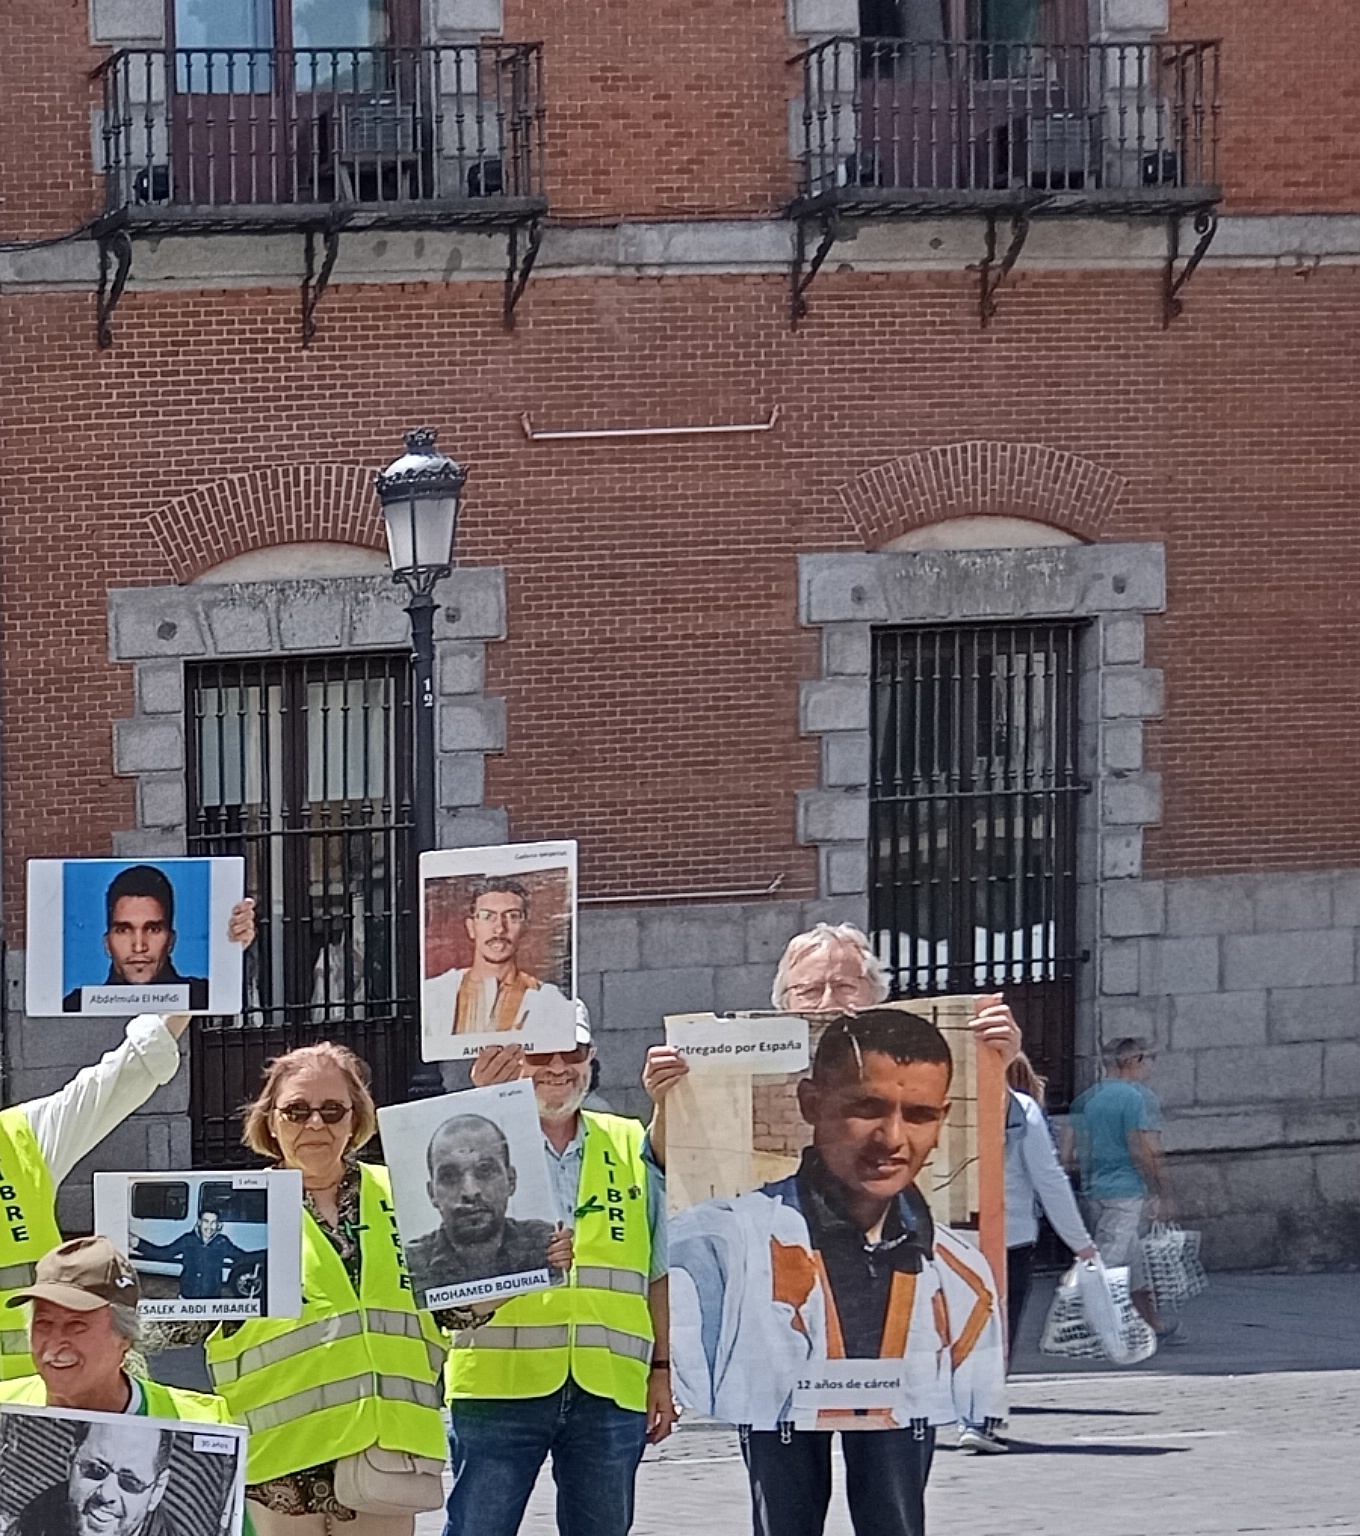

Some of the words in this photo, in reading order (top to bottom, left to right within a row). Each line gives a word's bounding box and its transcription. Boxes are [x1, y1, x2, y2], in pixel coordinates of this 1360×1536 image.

[735, 1042, 757, 1055] por
[759, 1040, 802, 1054] España
[603, 1150, 625, 1242] LIBRE
[429, 1284, 493, 1304] MOHAMED
[495, 1274, 548, 1292] BOURIAL
[180, 1304, 207, 1315] ABDI
[211, 1303, 258, 1314] MBAREK
[797, 1380, 811, 1390] 12
[814, 1379, 843, 1390] años
[845, 1379, 862, 1389] de
[863, 1377, 900, 1389] cárcel
